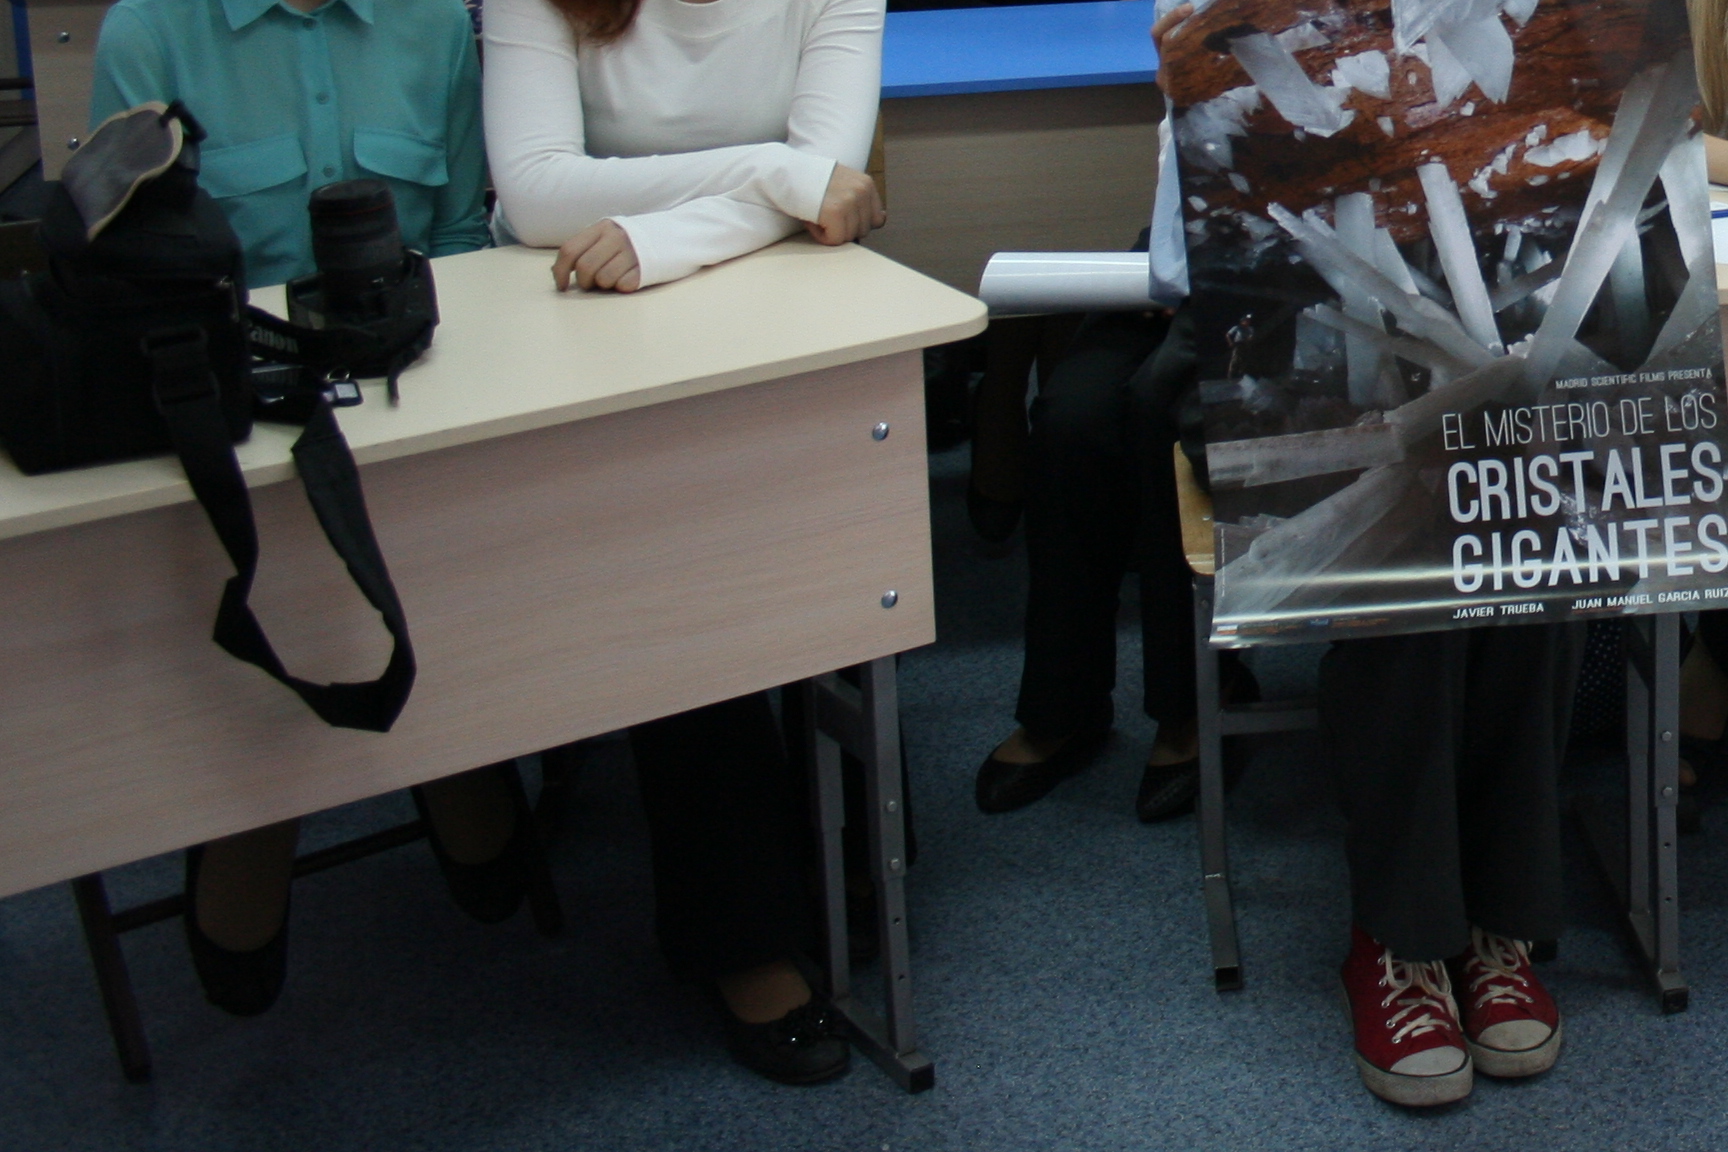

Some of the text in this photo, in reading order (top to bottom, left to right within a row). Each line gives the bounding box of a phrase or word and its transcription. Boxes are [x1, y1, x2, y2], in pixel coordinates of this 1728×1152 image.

[248, 321, 300, 354] anon
[1555, 368, 1713, 389] MADRID SCIENTIFIC FILMS PRESENTA
[1442, 393, 1718, 450] EL MISTERIO DE LOS
[1448, 441, 1724, 523] CRISTALES
[1453, 602, 1545, 619] JAVIER TRUEBA
[1571, 598, 1602, 610] JUAN
[1606, 594, 1653, 608] MANUEL
[1658, 590, 1700, 603] GARCIA
